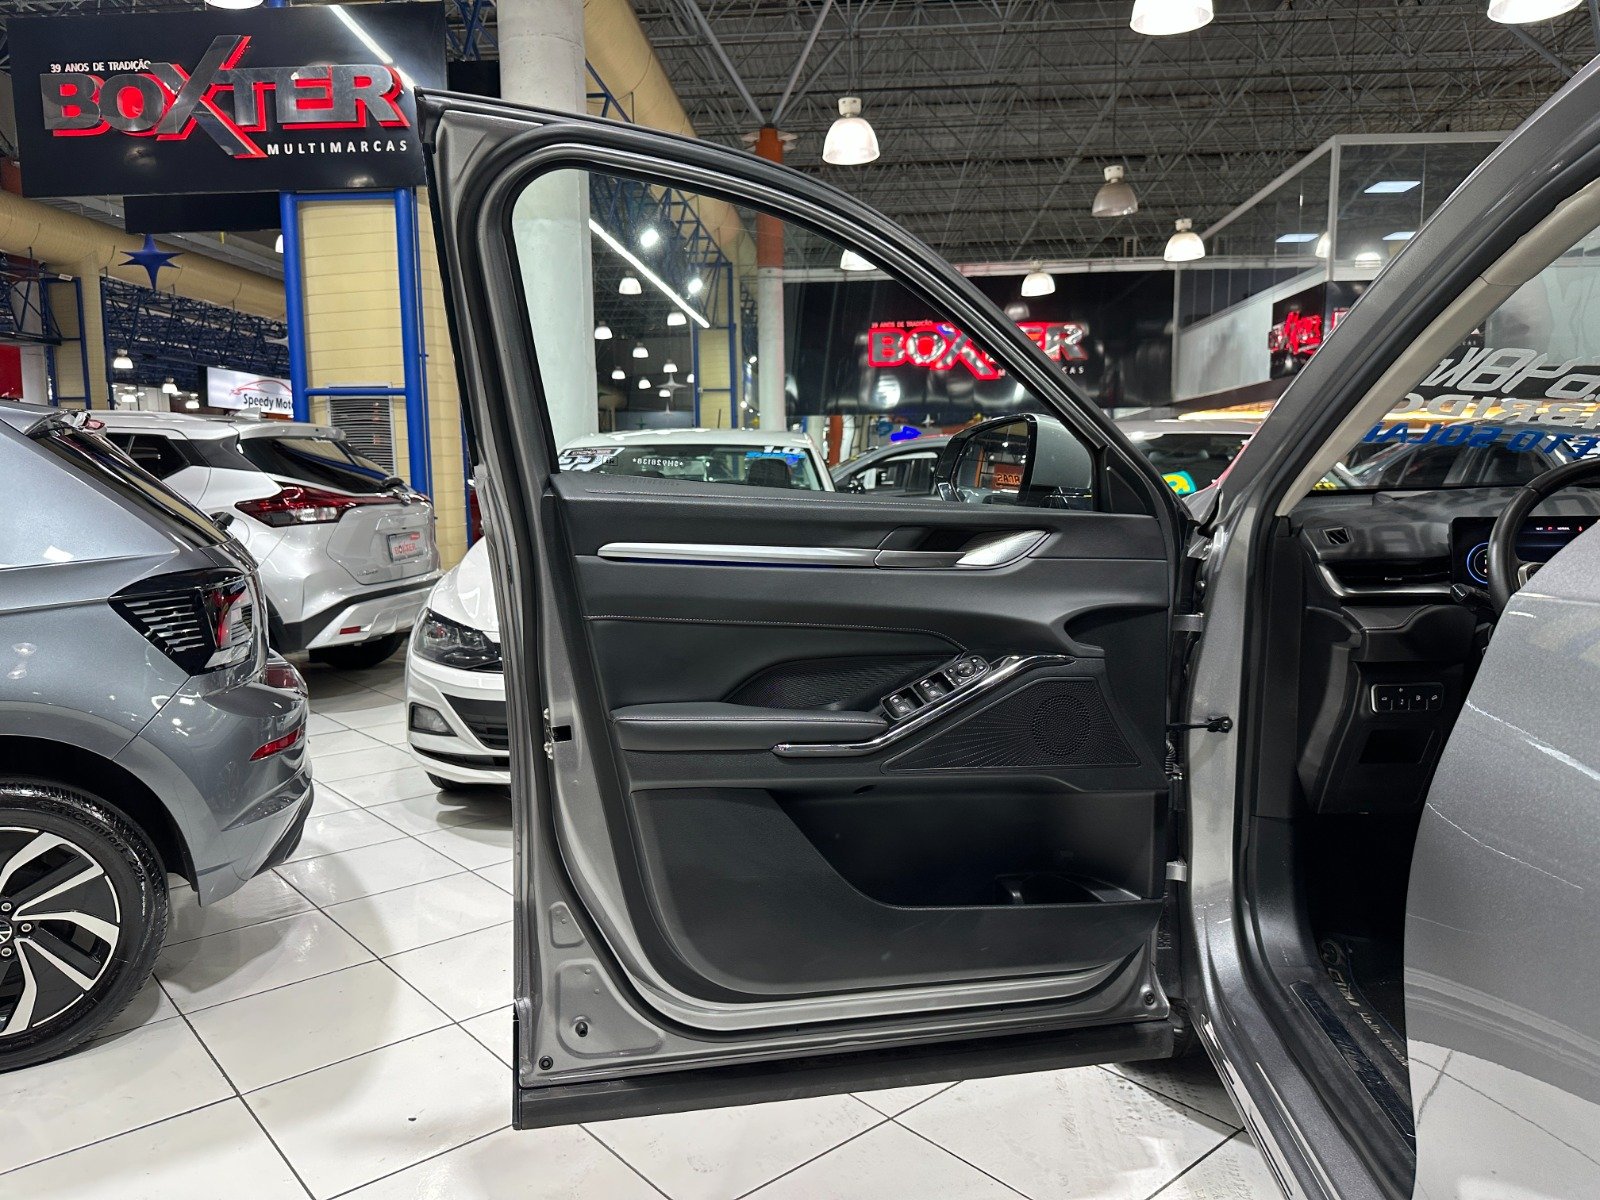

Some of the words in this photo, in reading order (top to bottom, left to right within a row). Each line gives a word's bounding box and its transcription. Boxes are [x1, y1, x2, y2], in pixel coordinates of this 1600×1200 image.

[50, 63, 61, 73] 39
[64, 62, 89, 72] ANOS
[92, 61, 104, 71] DE
[40, 35, 410, 159] BOXTER
[267, 139, 408, 155] MULTIMARCAS
[243, 394, 273, 410] Speedy
